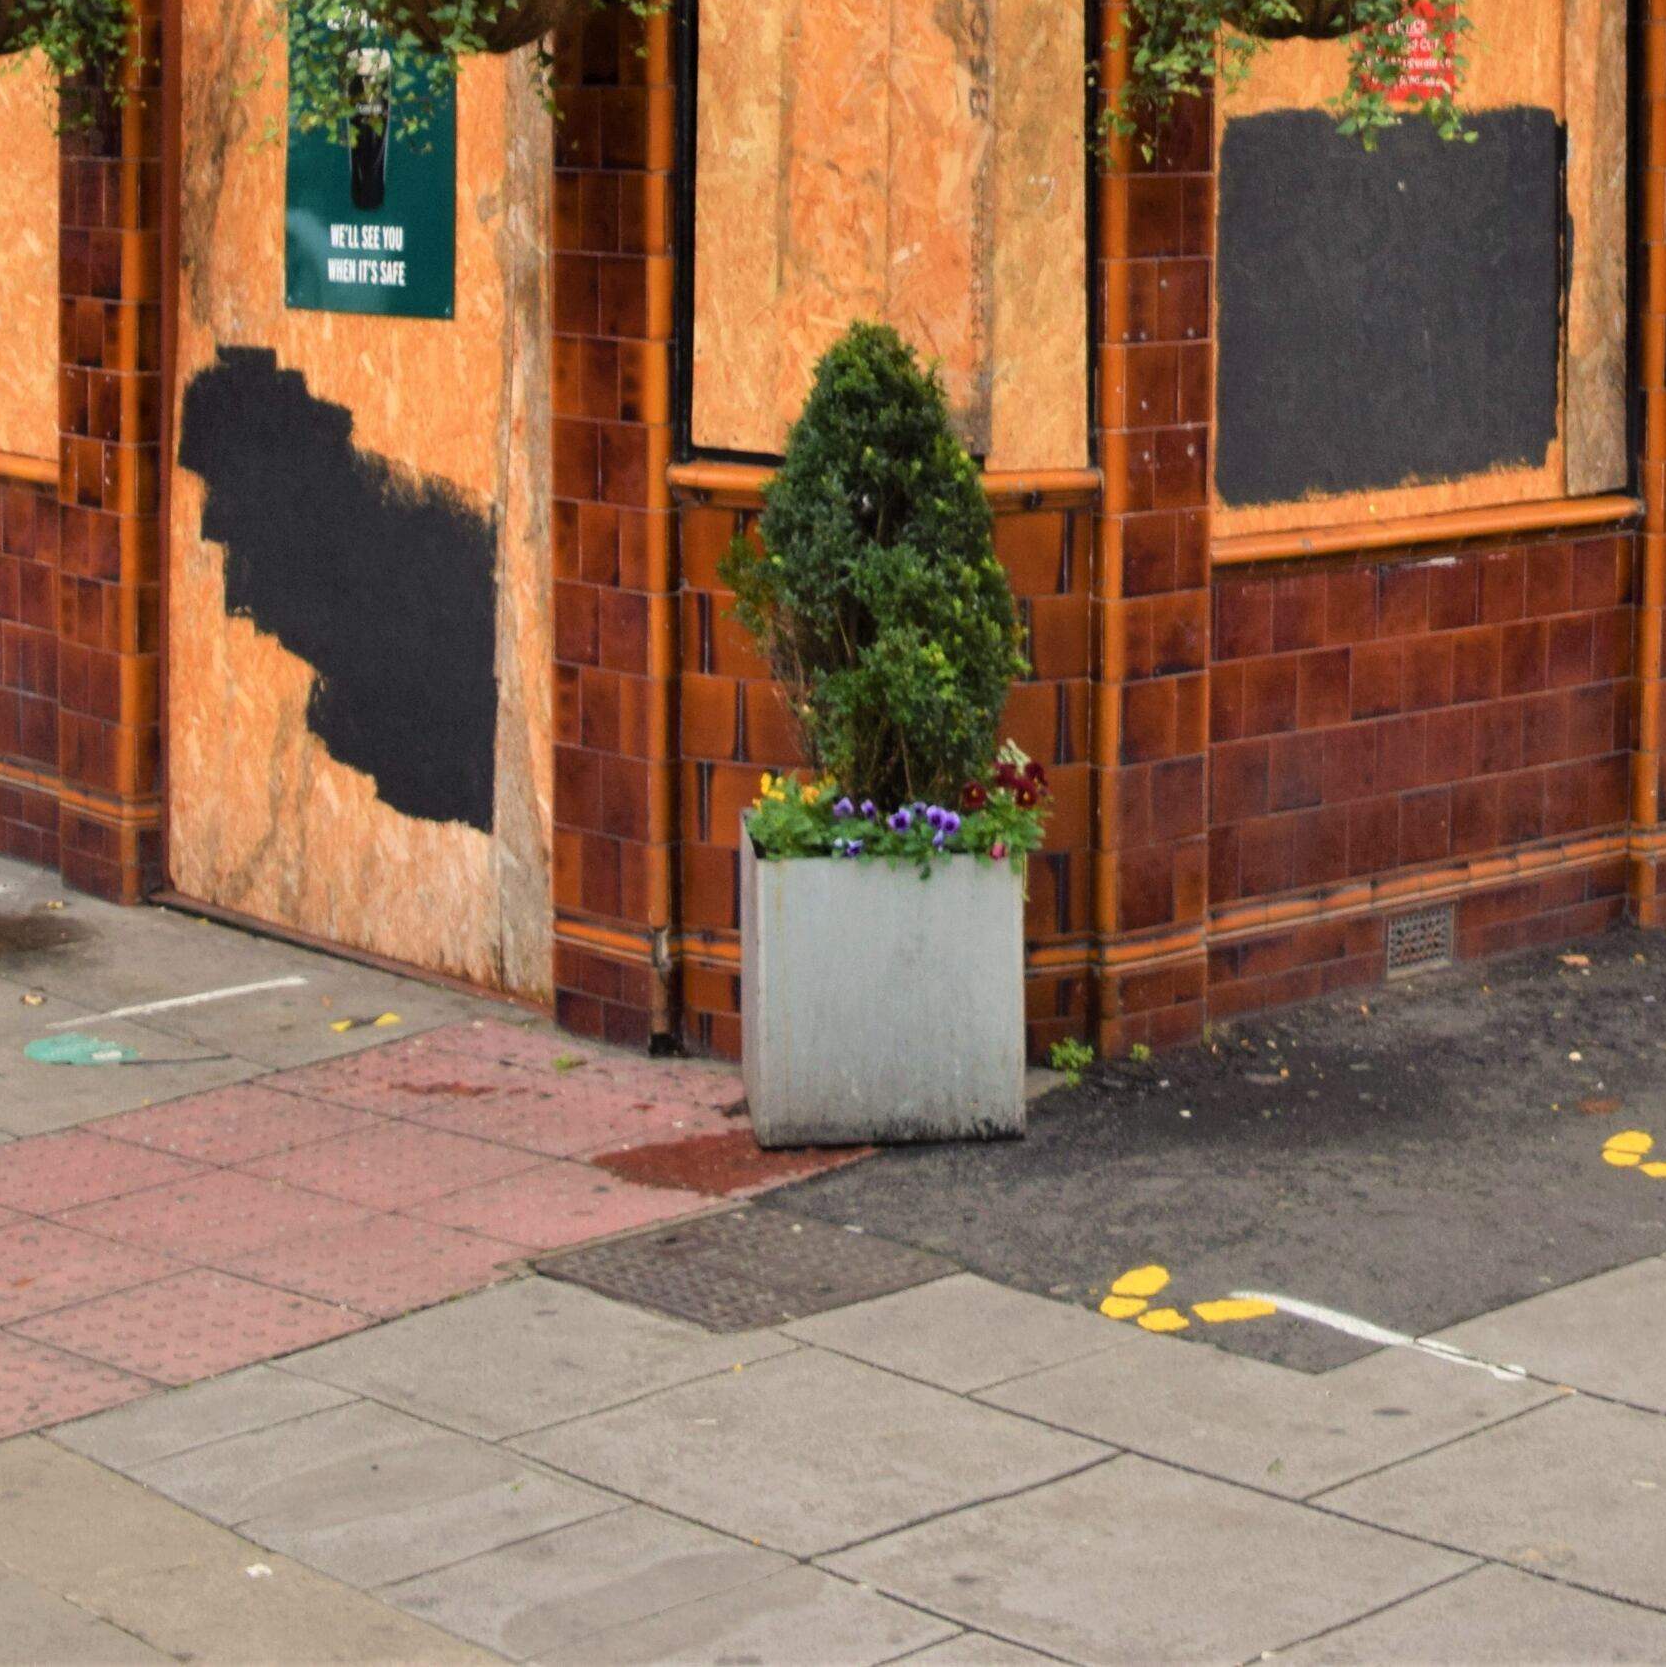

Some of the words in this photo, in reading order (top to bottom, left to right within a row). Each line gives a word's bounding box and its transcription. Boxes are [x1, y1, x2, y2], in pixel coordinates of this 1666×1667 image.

[330, 223, 360, 250] WE'LL
[361, 224, 381, 251] SEE
[382, 225, 404, 252] YOU
[327, 257, 356, 284] WHEN
[358, 258, 379, 285] IT'S
[379, 259, 407, 287] SAFE
